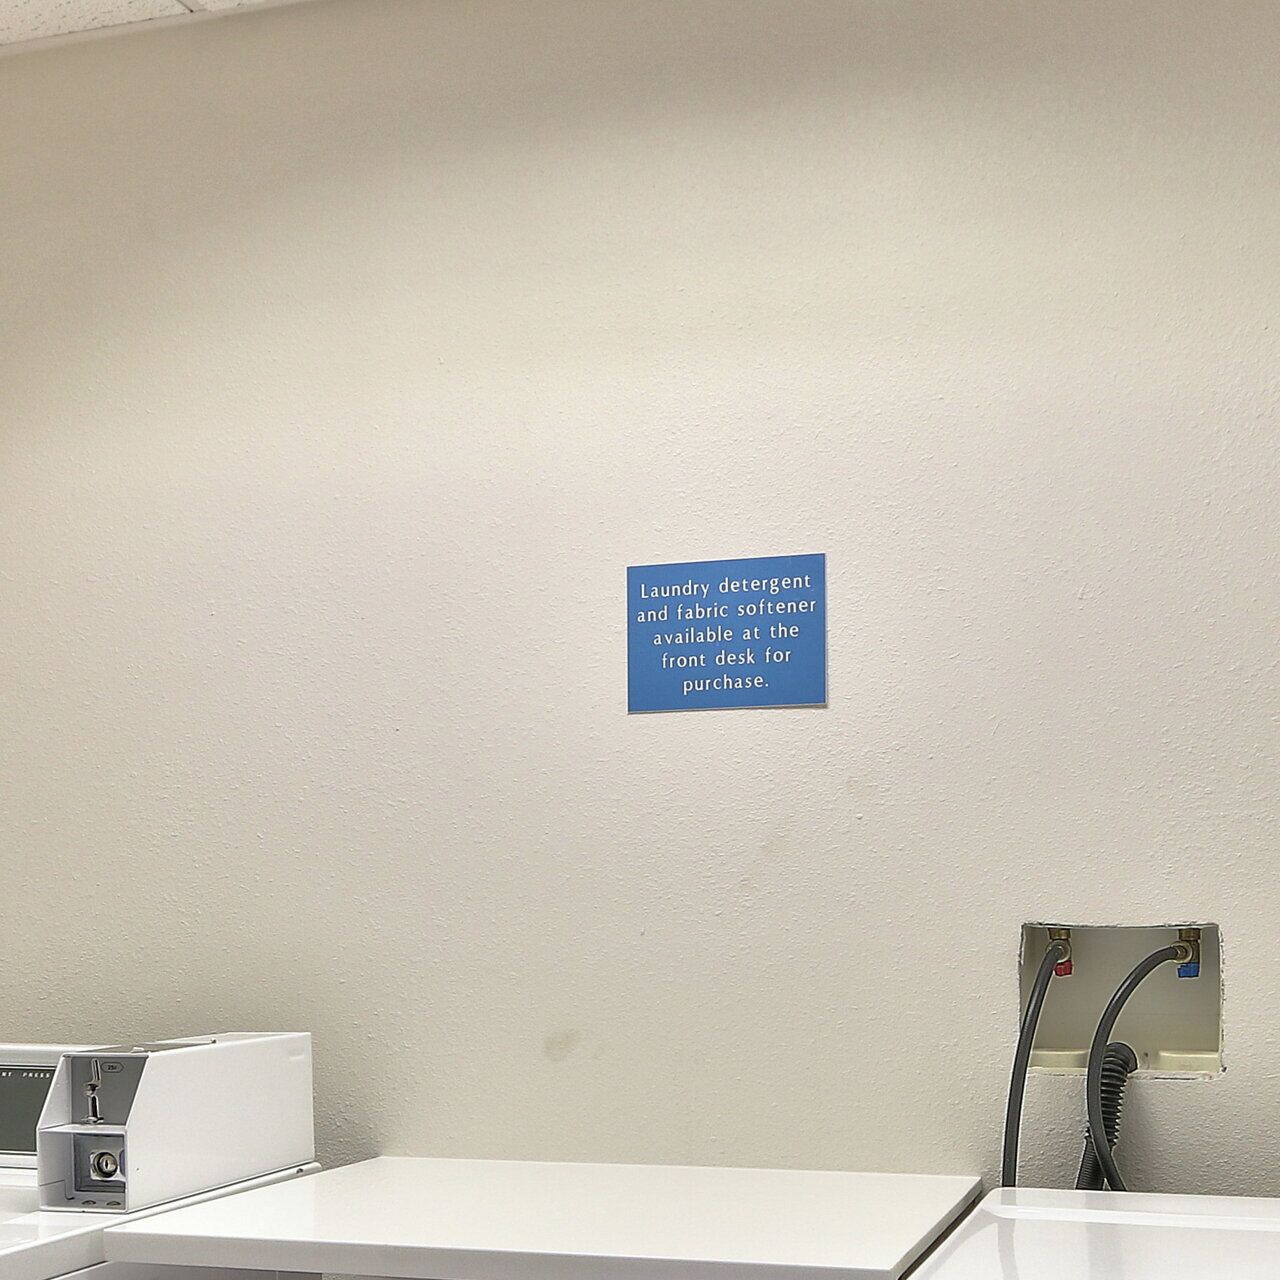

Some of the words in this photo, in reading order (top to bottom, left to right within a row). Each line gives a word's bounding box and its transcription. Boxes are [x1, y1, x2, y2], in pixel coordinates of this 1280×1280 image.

[640, 580, 709, 598] Laundry
[719, 575, 811, 594] detergent
[637, 606, 668, 622] and
[677, 602, 729, 620] fabric
[737, 599, 816, 616] softener
[653, 626, 733, 645] available
[742, 627, 760, 640] at
[770, 624, 799, 638] the
[662, 652, 706, 669] front
[715, 648, 755, 666] desk
[765, 647, 791, 663] for
[683, 674, 769, 695] purchase.
